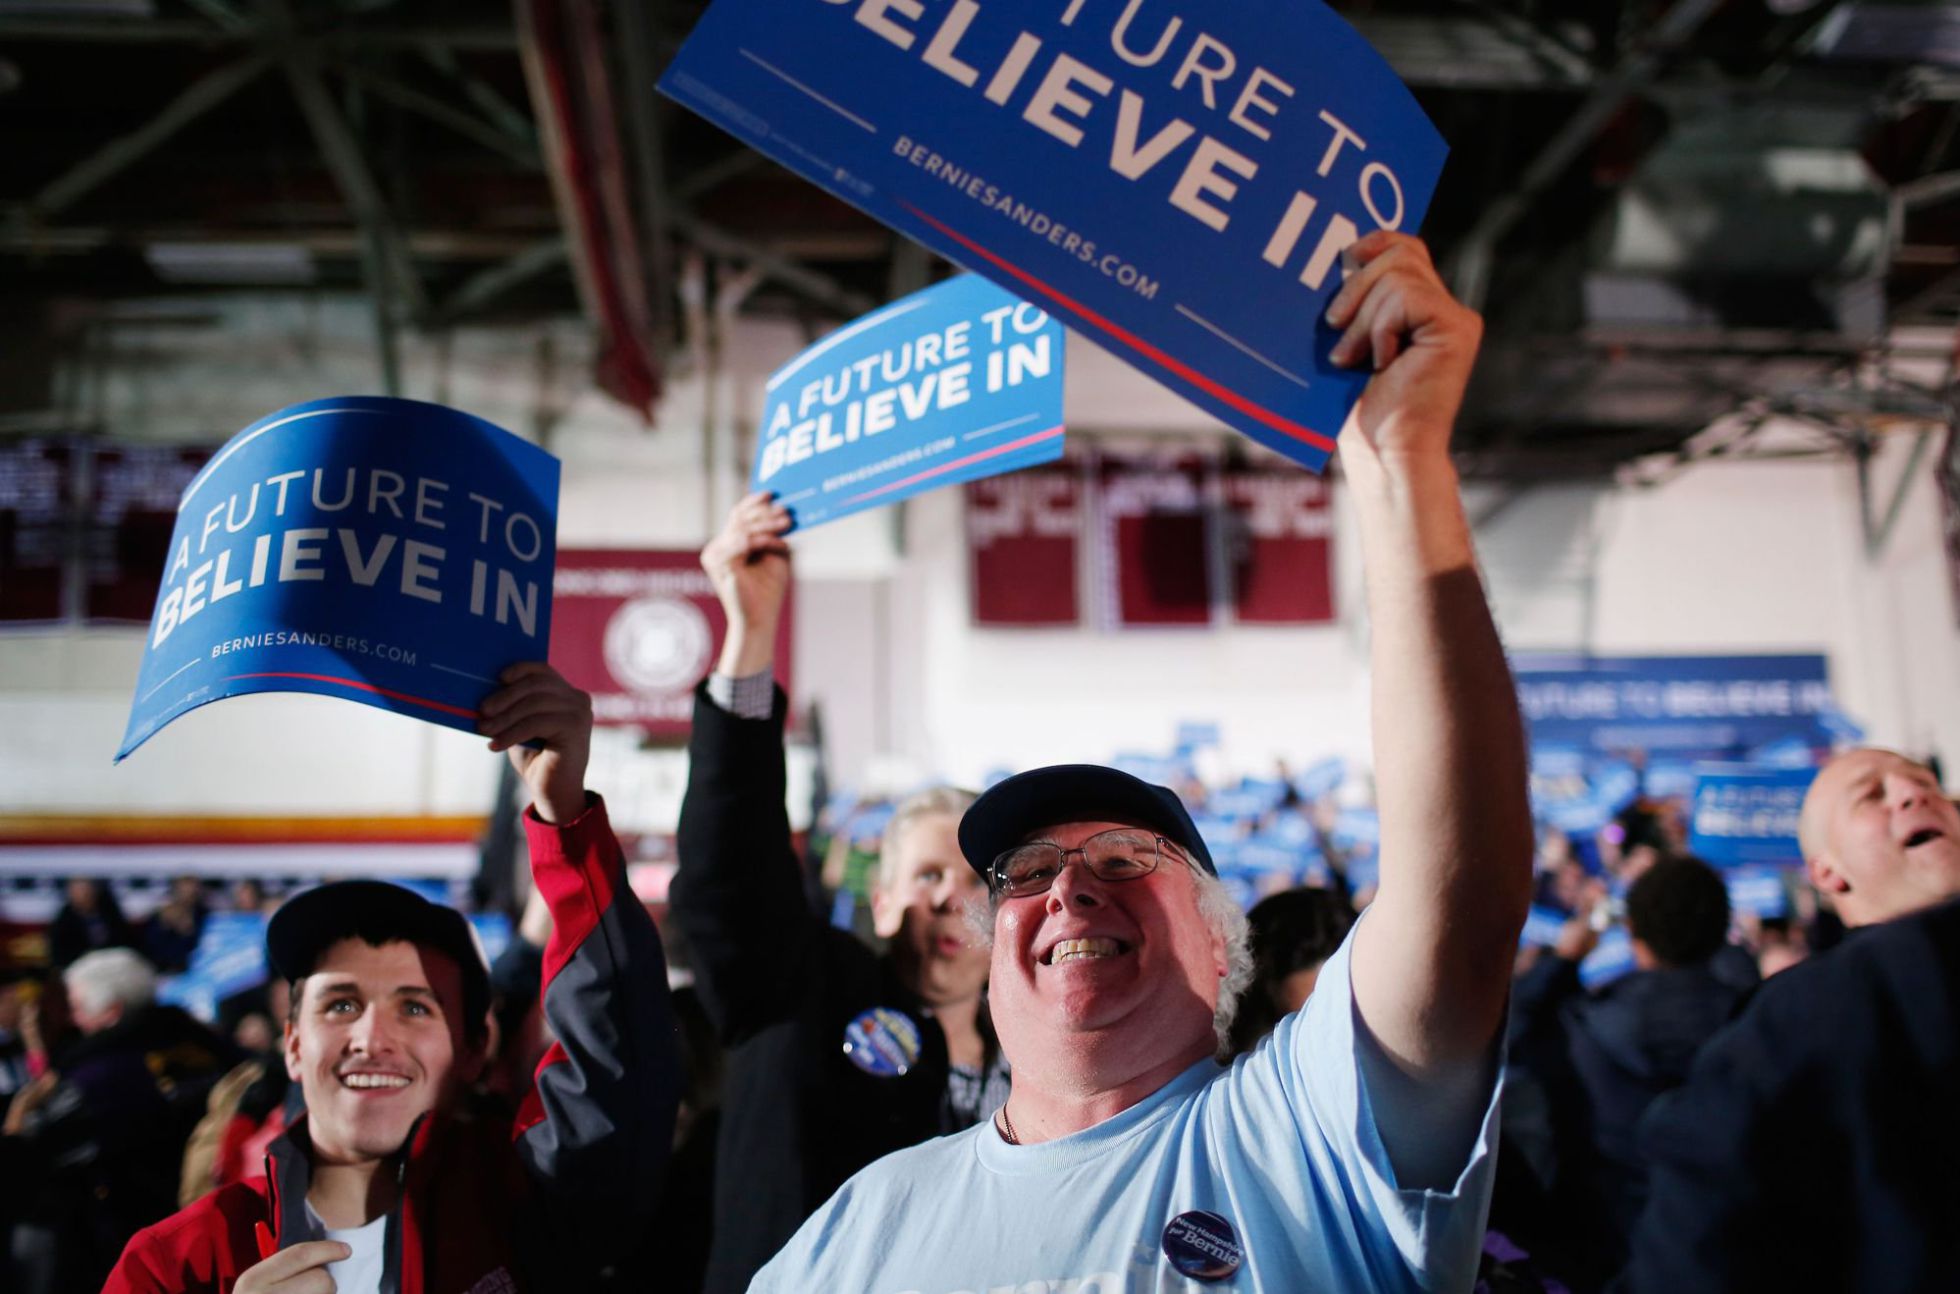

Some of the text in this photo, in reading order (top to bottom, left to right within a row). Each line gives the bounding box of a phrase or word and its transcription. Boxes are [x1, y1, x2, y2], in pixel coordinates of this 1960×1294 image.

[821, 0, 1259, 233] ELIEVE
[1315, 109, 1404, 231] TO
[892, 134, 1161, 301] BERNIESANDERS.COM
[757, 333, 1051, 484] BELIEVE IN
[767, 301, 1050, 440] A FUTURE TO
[167, 532, 190, 586] A
[197, 466, 450, 555] FUTURE
[468, 491, 542, 563] TO
[151, 527, 539, 651] BELIEVE IN
[211, 630, 418, 667] BERNIESANDERS.COM
[1168, 1226, 1240, 1267] for Bernie
[1176, 1216, 1245, 1257] New Hampshire
